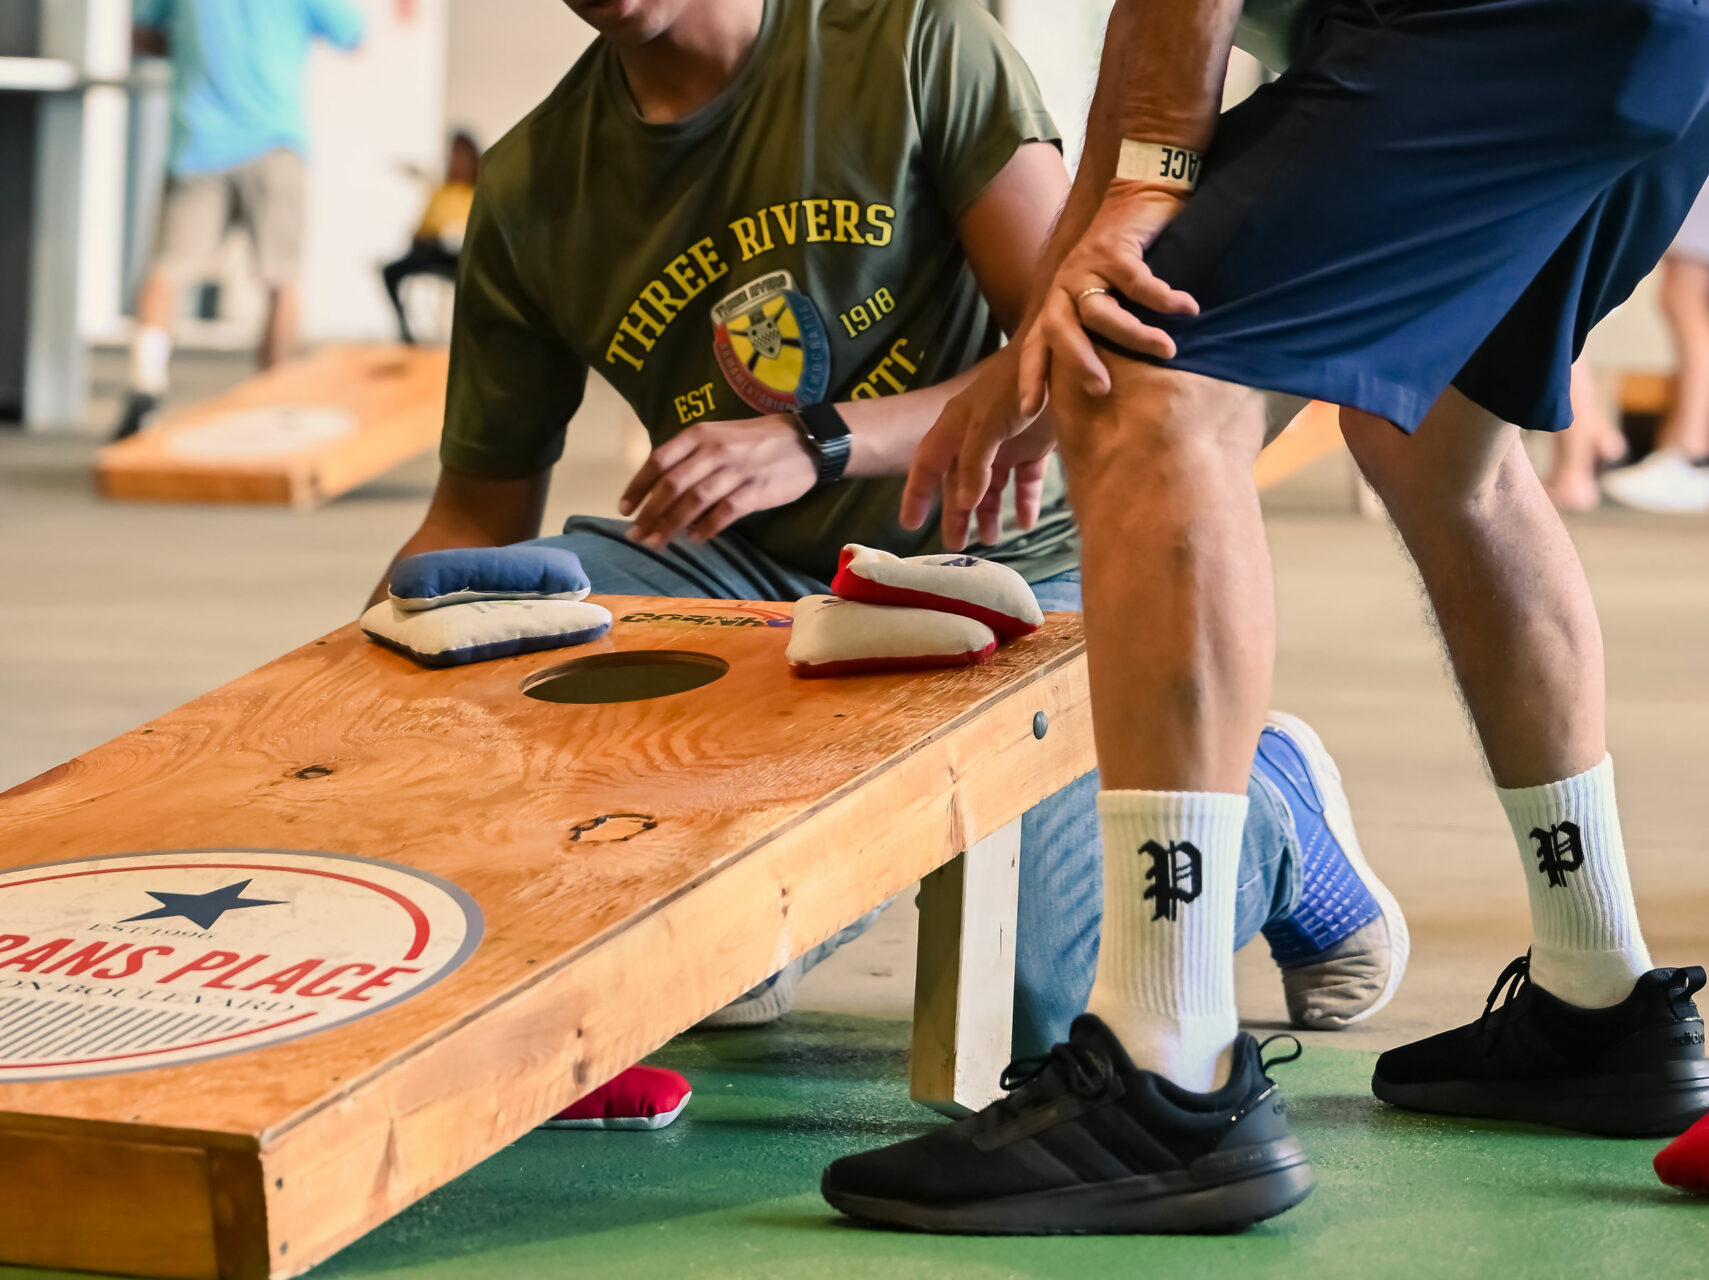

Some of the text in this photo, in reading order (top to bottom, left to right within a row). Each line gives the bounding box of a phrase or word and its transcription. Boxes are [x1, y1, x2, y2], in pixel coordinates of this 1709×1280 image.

[605, 236, 729, 372] THREE
[728, 199, 896, 262] RIVERS
[673, 382, 717, 424] EST
[839, 287, 896, 339] 1918
[1138, 839, 1202, 921] P
[1529, 820, 1585, 888] P
[157, 950, 423, 1002] PLACE
